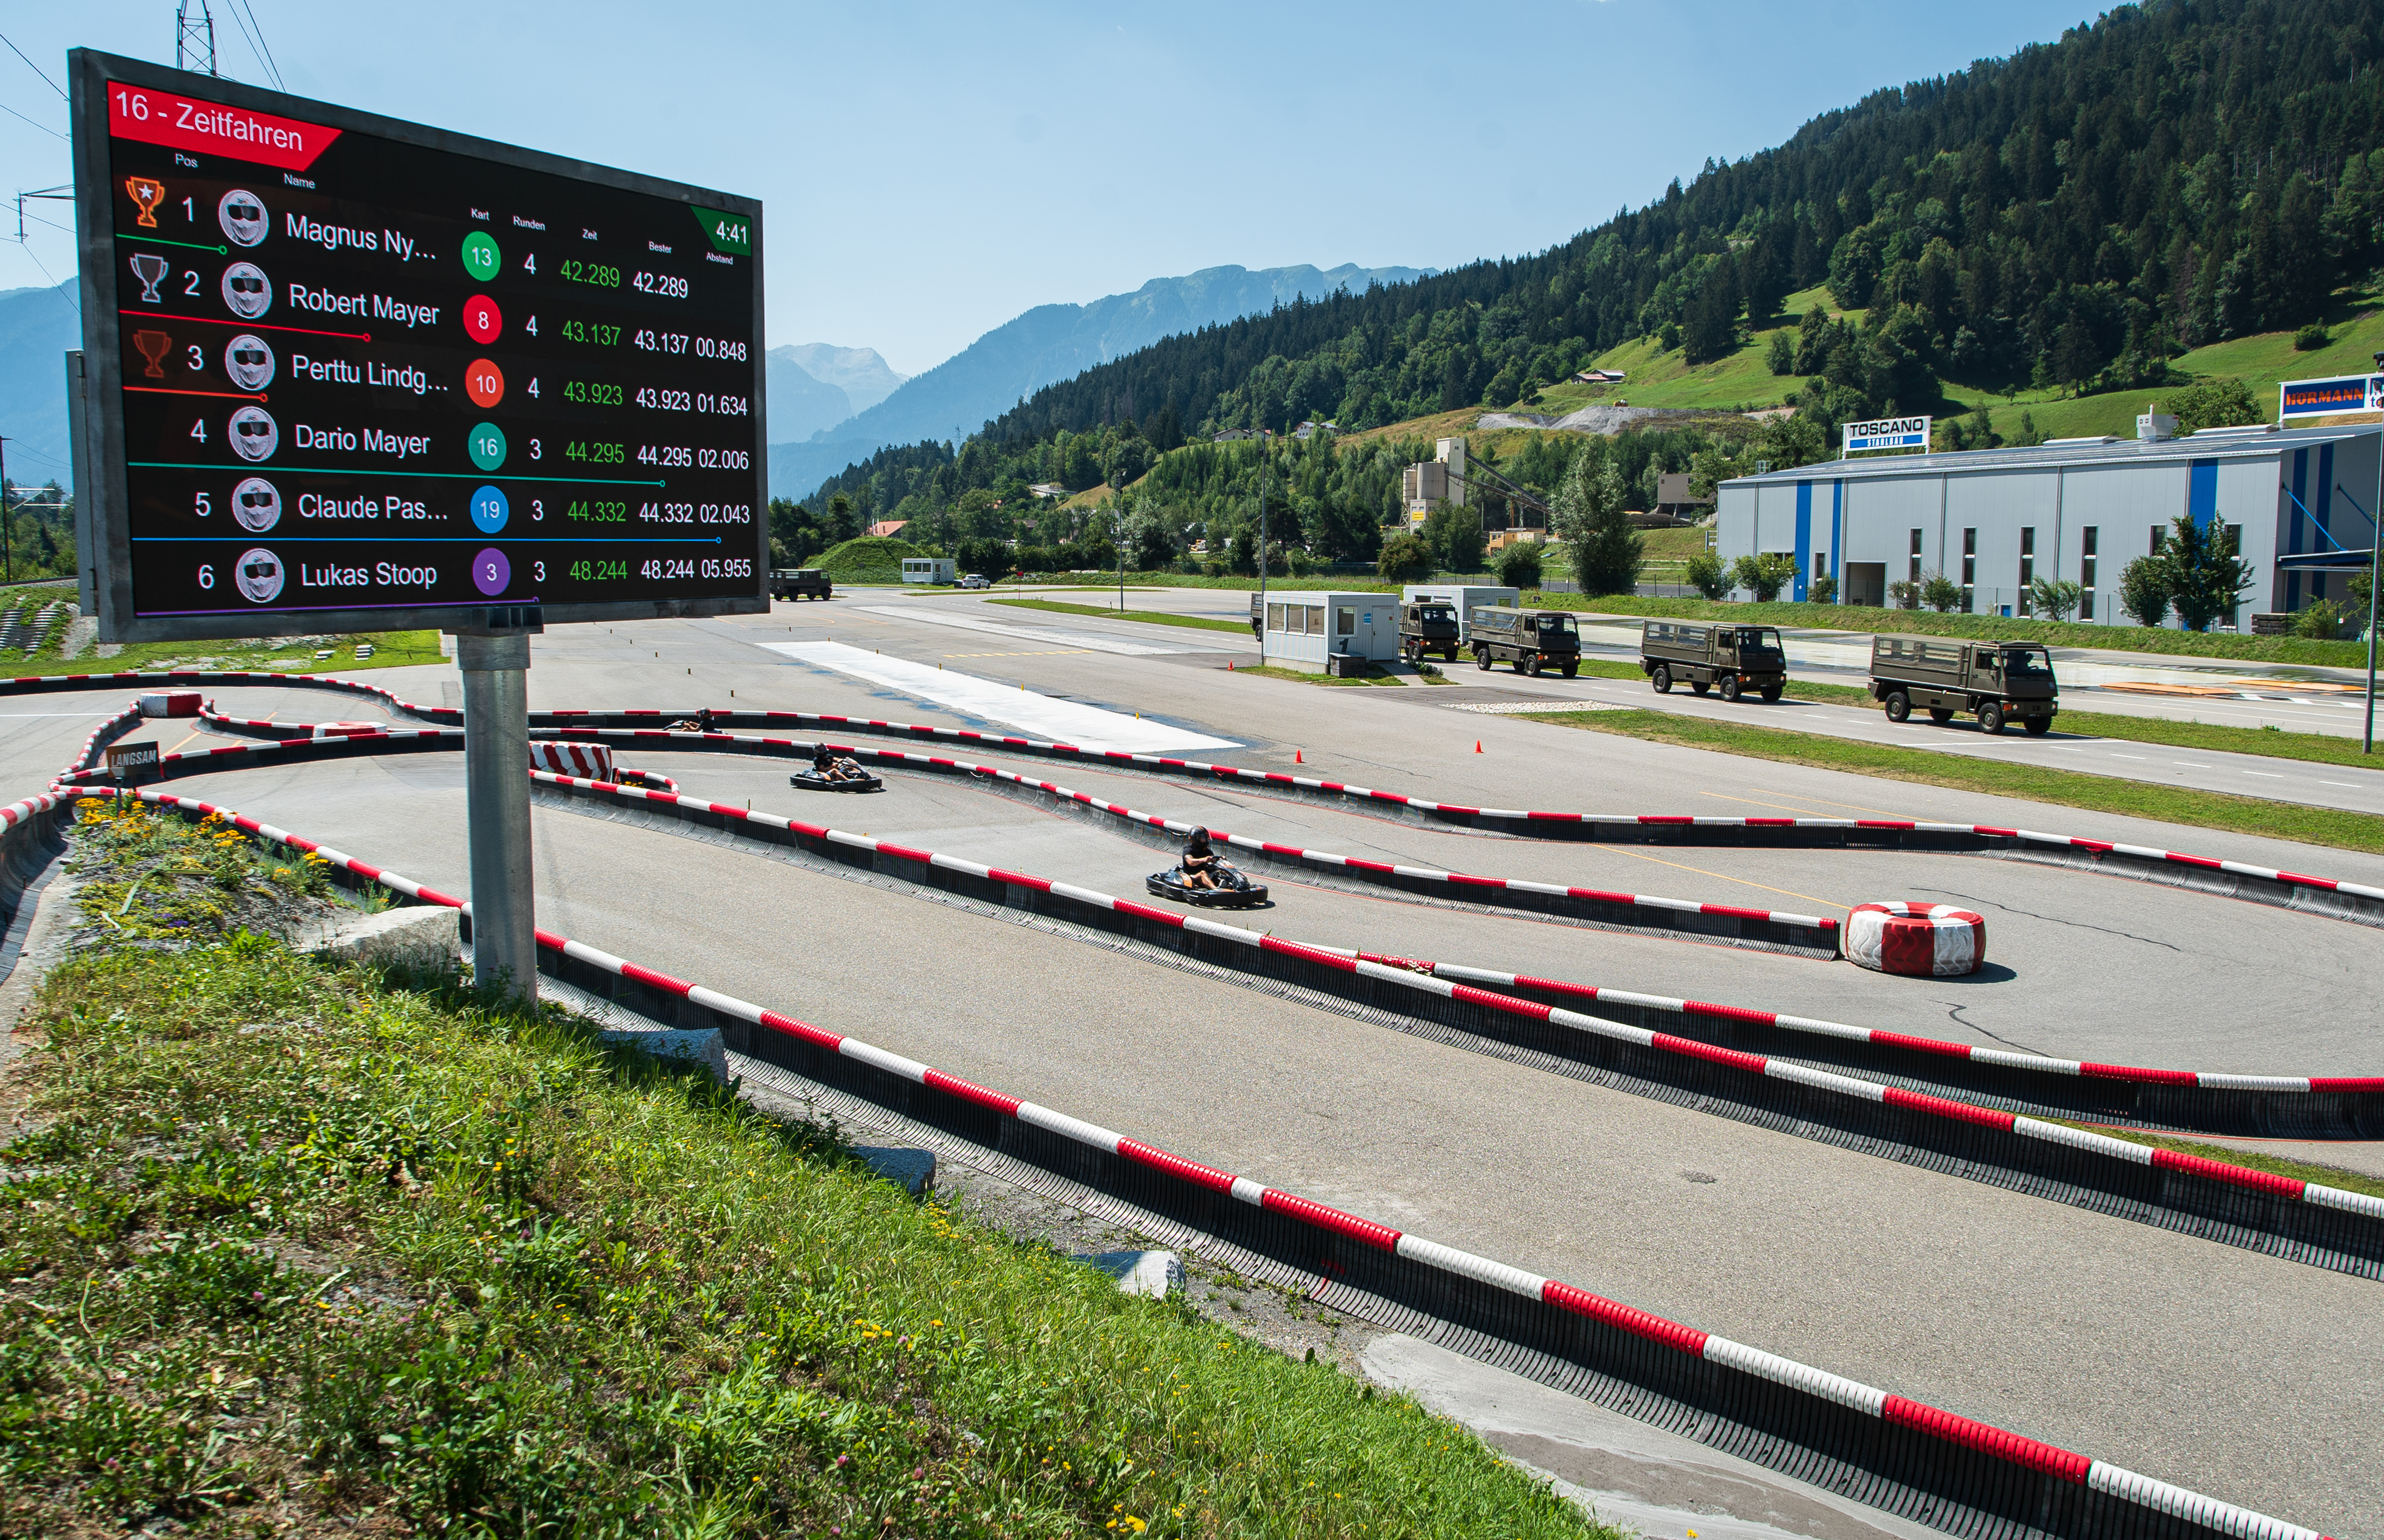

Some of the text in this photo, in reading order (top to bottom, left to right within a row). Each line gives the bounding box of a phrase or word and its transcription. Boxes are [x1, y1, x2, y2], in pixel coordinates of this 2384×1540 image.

[116, 91, 148, 121] 16
[175, 102, 302, 152] Zeitfahren
[175, 153, 734, 266] Pos Name Kart Runden Zeit Bester Abstand
[182, 196, 193, 222] 1
[286, 212, 378, 250] Magnus
[472, 246, 492, 267] 13
[524, 253, 536, 275] 4
[560, 259, 621, 288] 42.289
[633, 271, 688, 298] 42.289
[716, 220, 747, 245] 4:41
[184, 270, 747, 362] 2 Robert Mayer 8 4 43.137 43.137 00.848
[188, 345, 203, 371] 3
[293, 354, 360, 383] Perttu
[476, 374, 496, 394] 10
[528, 377, 540, 399] 4
[563, 381, 623, 406] 43.923
[636, 387, 691, 412] 43.923
[697, 393, 748, 416] 01.634
[2286, 387, 2364, 406] HÖRMANN
[1849, 418, 1923, 437] TOSCANO
[1867, 436, 1904, 447] STAHLBAU
[190, 418, 749, 470] 4 Dario Mayer 16 3 44.295 44.295 02.006
[195, 492, 211, 517] 5
[298, 494, 379, 519] Claude
[480, 500, 500, 519] 19
[532, 499, 544, 521] 3
[567, 500, 627, 522] 44.332
[639, 502, 694, 524] 44.332
[700, 503, 750, 524] 02.043
[198, 558, 752, 590] 6 Lukas Stoop 3 3 48.244 48.244 05.955
[934, 573, 941, 582] 3
[1338, 638, 1349, 653] 1
[111, 749, 156, 767] LANGSAM
